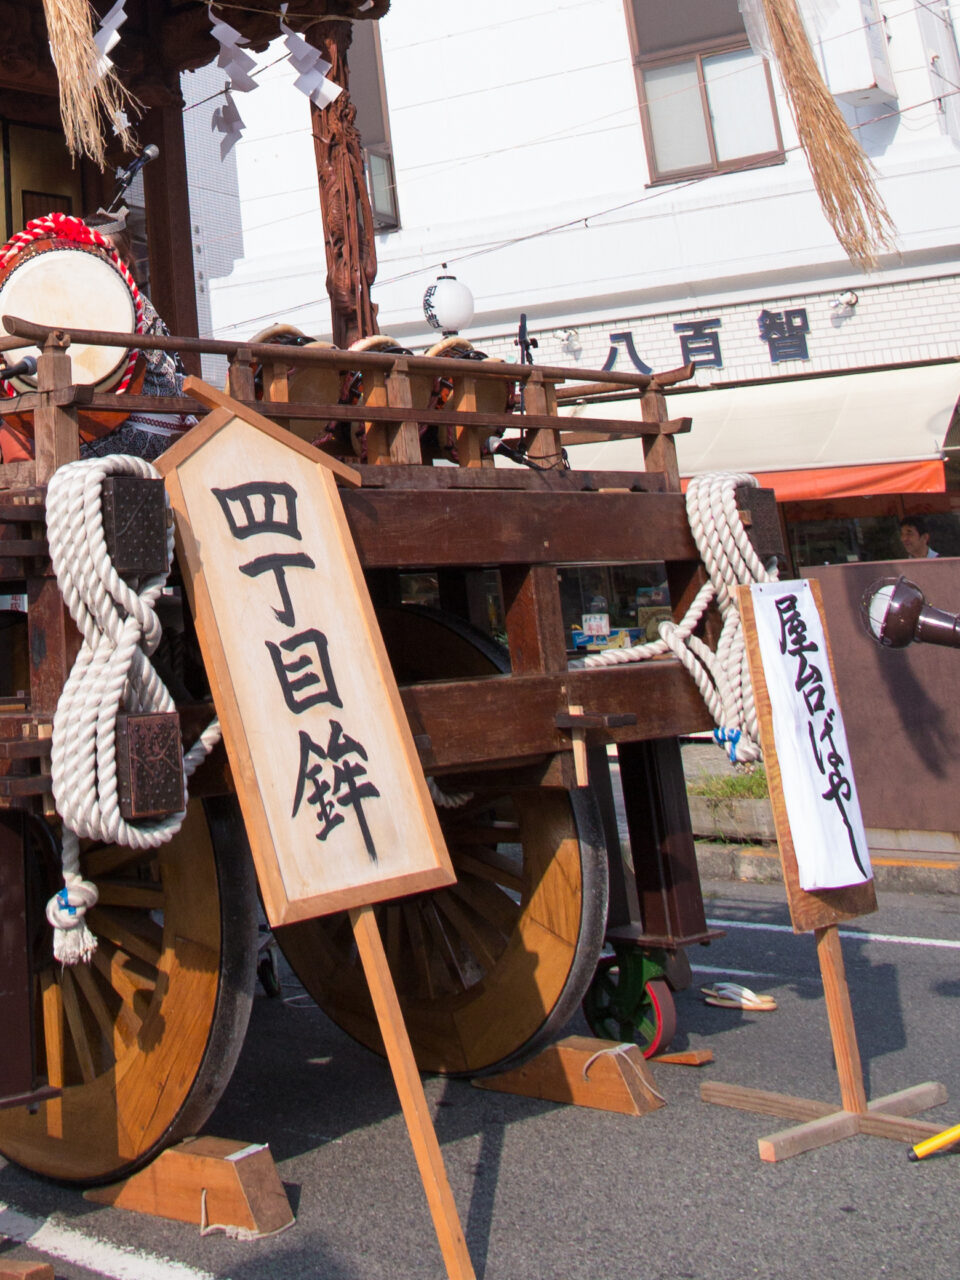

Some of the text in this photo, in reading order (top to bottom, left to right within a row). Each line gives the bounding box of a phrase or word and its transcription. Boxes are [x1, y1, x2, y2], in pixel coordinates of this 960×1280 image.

[601, 308, 811, 375] 八百智
[211, 481, 381, 864] 四丁目鉾
[775, 594, 868, 879] 屋台ばやし
